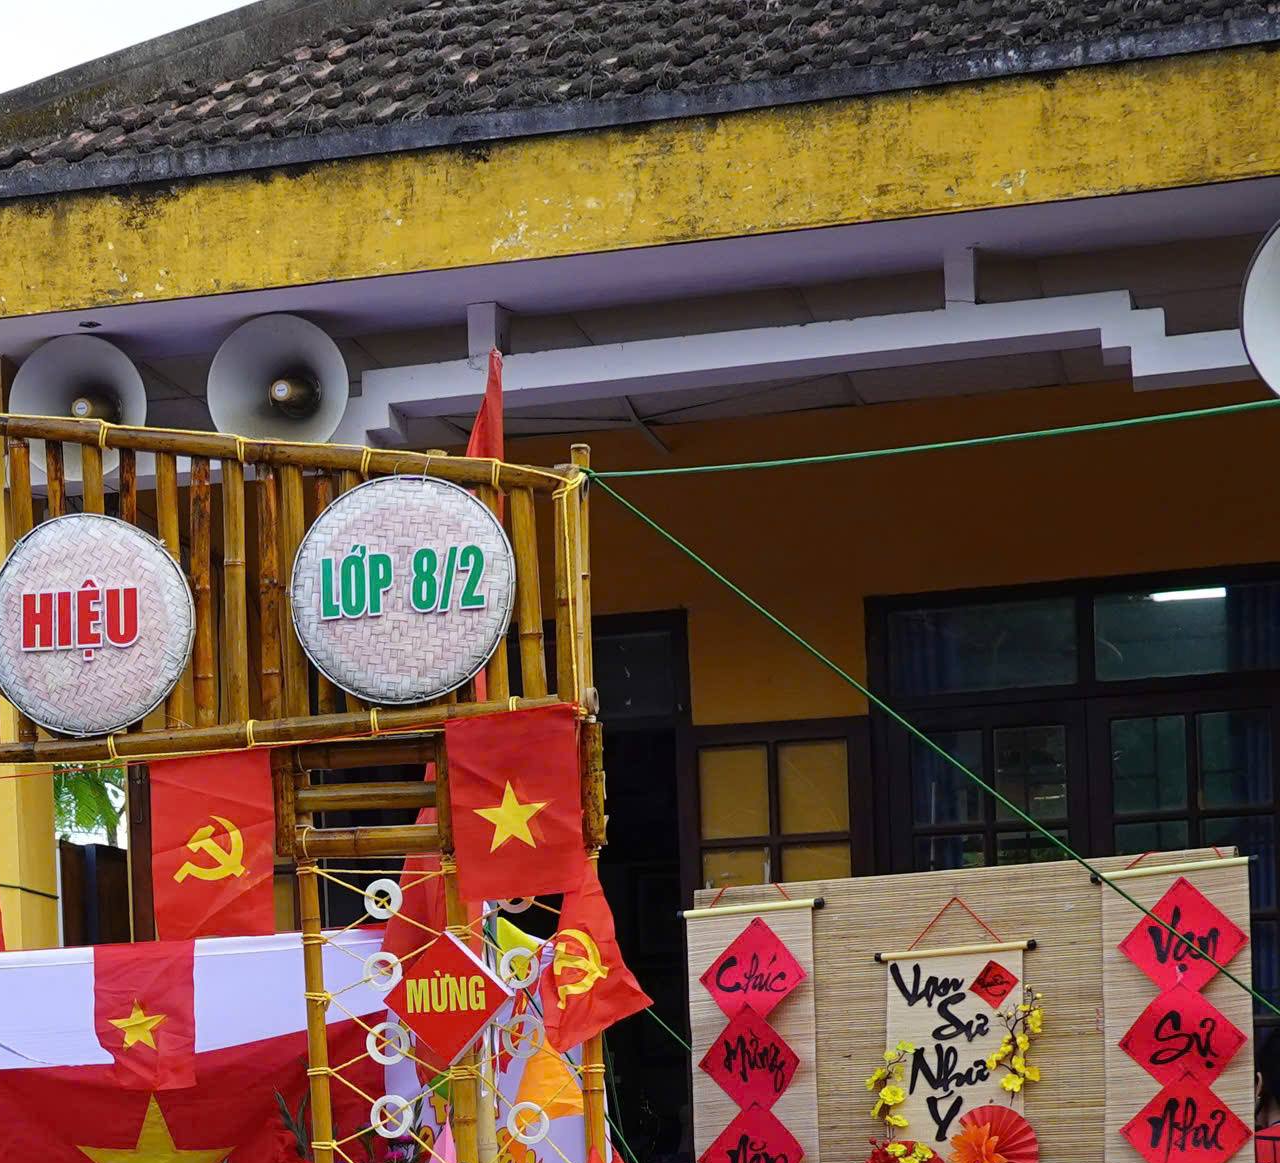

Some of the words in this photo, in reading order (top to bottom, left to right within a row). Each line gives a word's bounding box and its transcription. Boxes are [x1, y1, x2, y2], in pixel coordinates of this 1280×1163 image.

[320, 544, 393, 621] LỚP
[411, 544, 486, 613] 8/2
[20, 580, 140, 661] HIỆU
[1148, 906, 1219, 972] Vạn
[406, 970, 486, 1014] MỪNG
[716, 952, 786, 993] Chúc
[724, 1028, 785, 1092] Mừng
[909, 1043, 990, 1095] Như
[1150, 1010, 1218, 1068] Sự
[1147, 1098, 1226, 1163] Như
